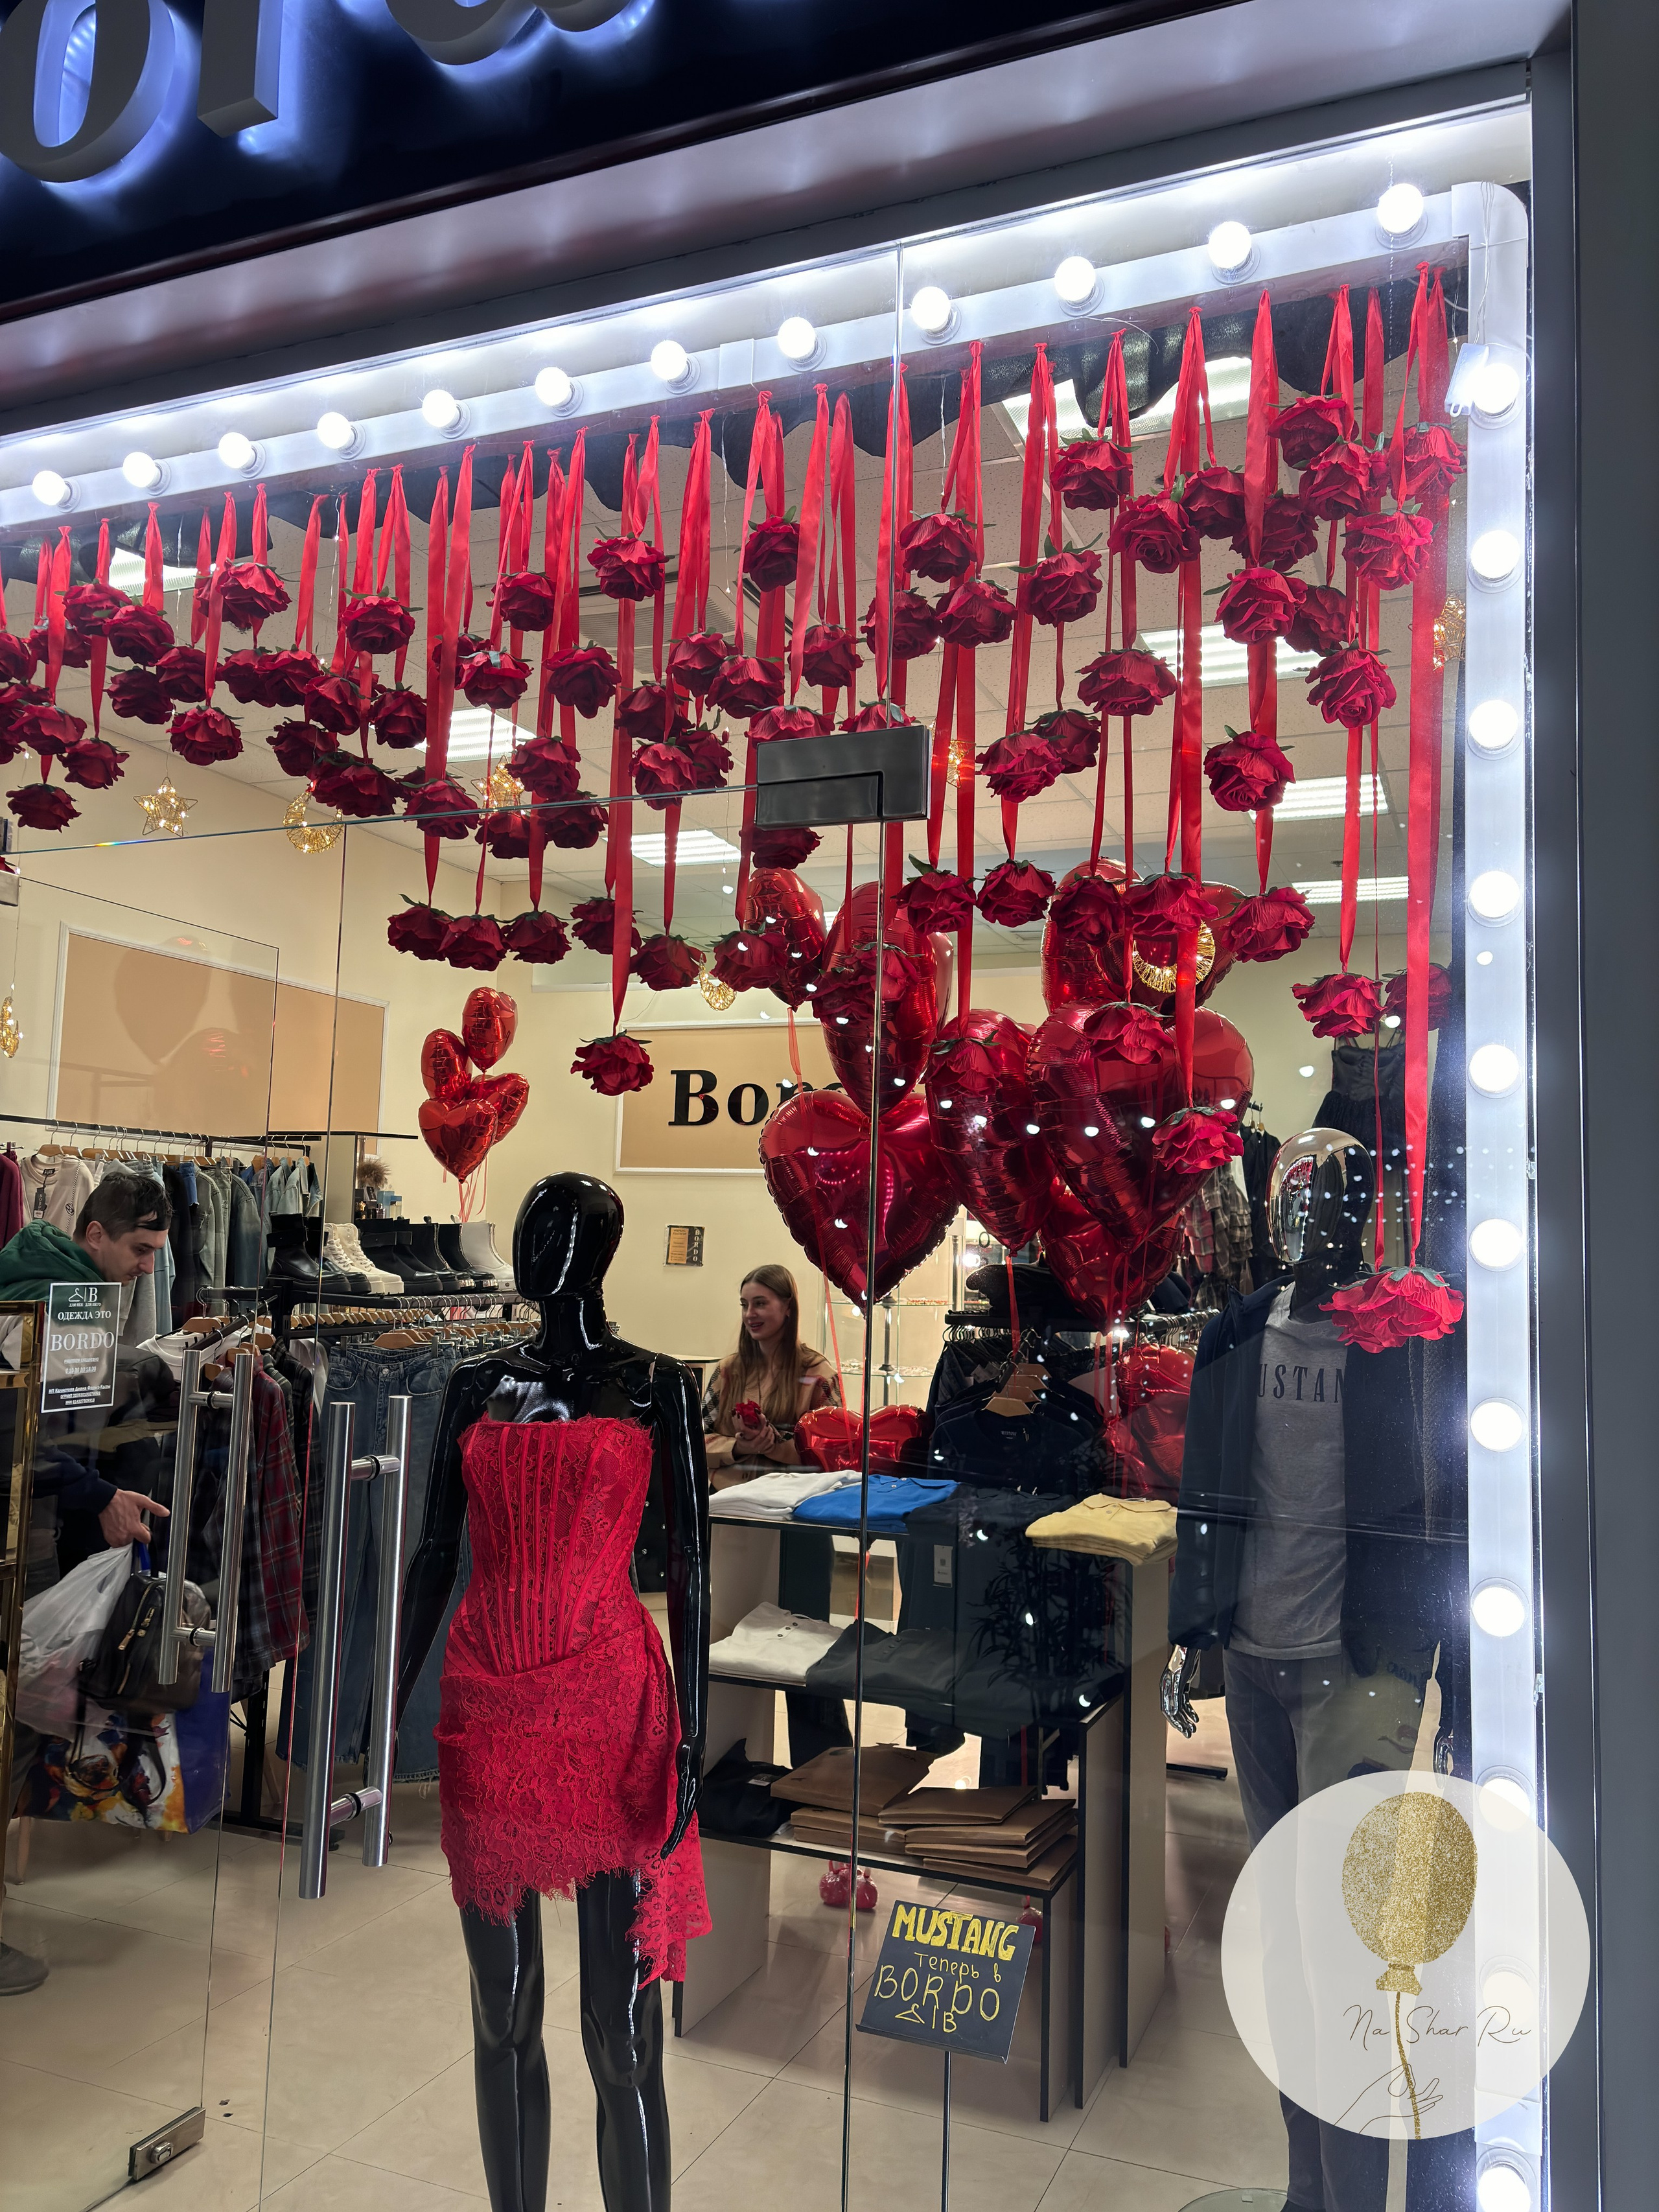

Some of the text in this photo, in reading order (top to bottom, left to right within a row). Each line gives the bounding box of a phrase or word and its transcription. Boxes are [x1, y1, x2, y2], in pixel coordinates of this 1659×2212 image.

[668, 1069, 844, 1126] Bor
[58, 1310, 111, 1321] ОДЕЖДА ЭТО
[50, 1331, 115, 1351] BORDO
[1257, 1364, 1345, 1403] USTAN
[892, 1904, 1019, 1961] MUSTANG
[874, 1965, 1000, 2021] BORDO
